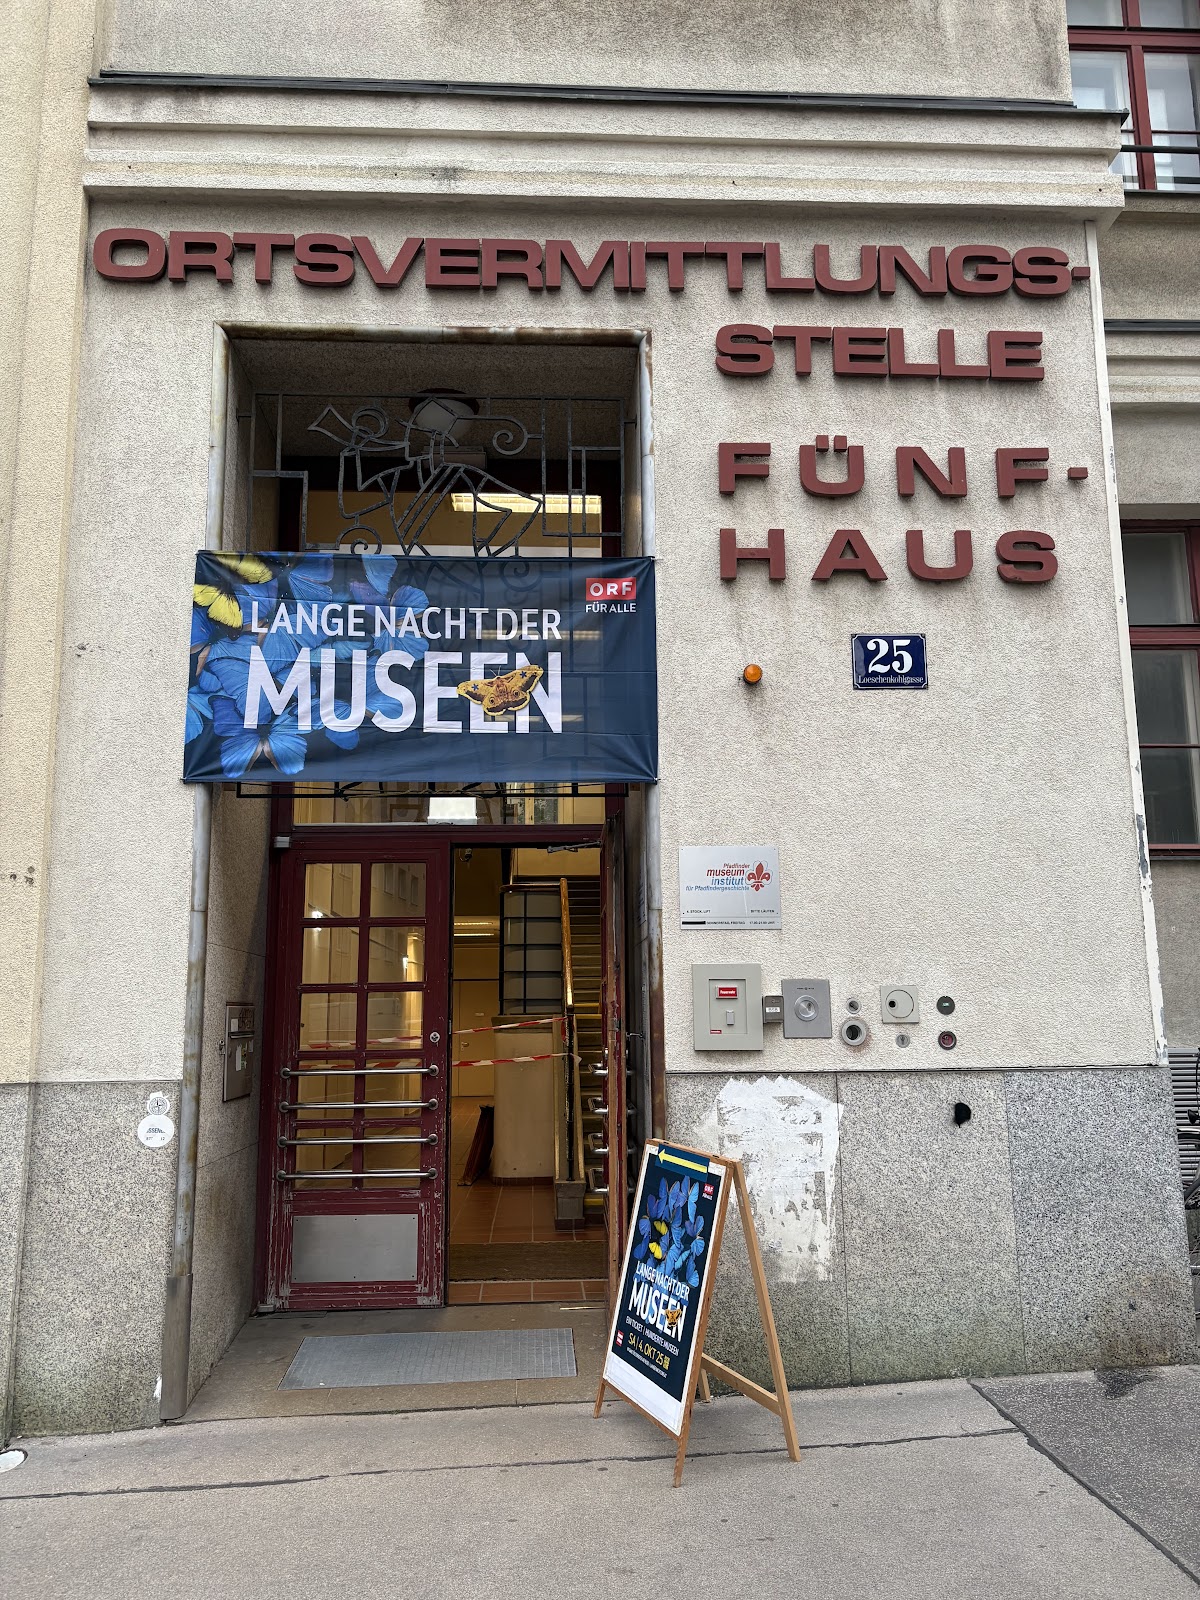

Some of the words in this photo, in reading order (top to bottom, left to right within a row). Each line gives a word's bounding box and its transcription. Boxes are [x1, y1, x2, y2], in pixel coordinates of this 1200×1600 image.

[93, 228, 1090, 300] ORTSVERMITTLUNGS-
[716, 324, 1044, 382] STELLE
[719, 435, 1088, 500] FÜNF-
[720, 529, 1057, 586] HAUS
[586, 602, 608, 614] FÜR
[608, 603, 637, 614] ALLE
[589, 581, 633, 596] ORF
[252, 601, 366, 638] LANGE
[374, 606, 489, 641] NACHT
[496, 608, 562, 641] DER
[866, 638, 913, 674] 25
[242, 645, 563, 734] MUSEEN
[858, 675, 924, 685] Loeschenkohlgasse
[706, 869, 745, 877] museum
[711, 876, 745, 886] institut
[636, 1261, 657, 1283] LANGE
[654, 1270, 677, 1296] NACHT
[676, 1281, 690, 1301] DER
[628, 1278, 687, 1343] MUSEEN
[628, 1332, 636, 1347] SA
[644, 1343, 657, 1360] OKT
[655, 1351, 664, 1366] 25
